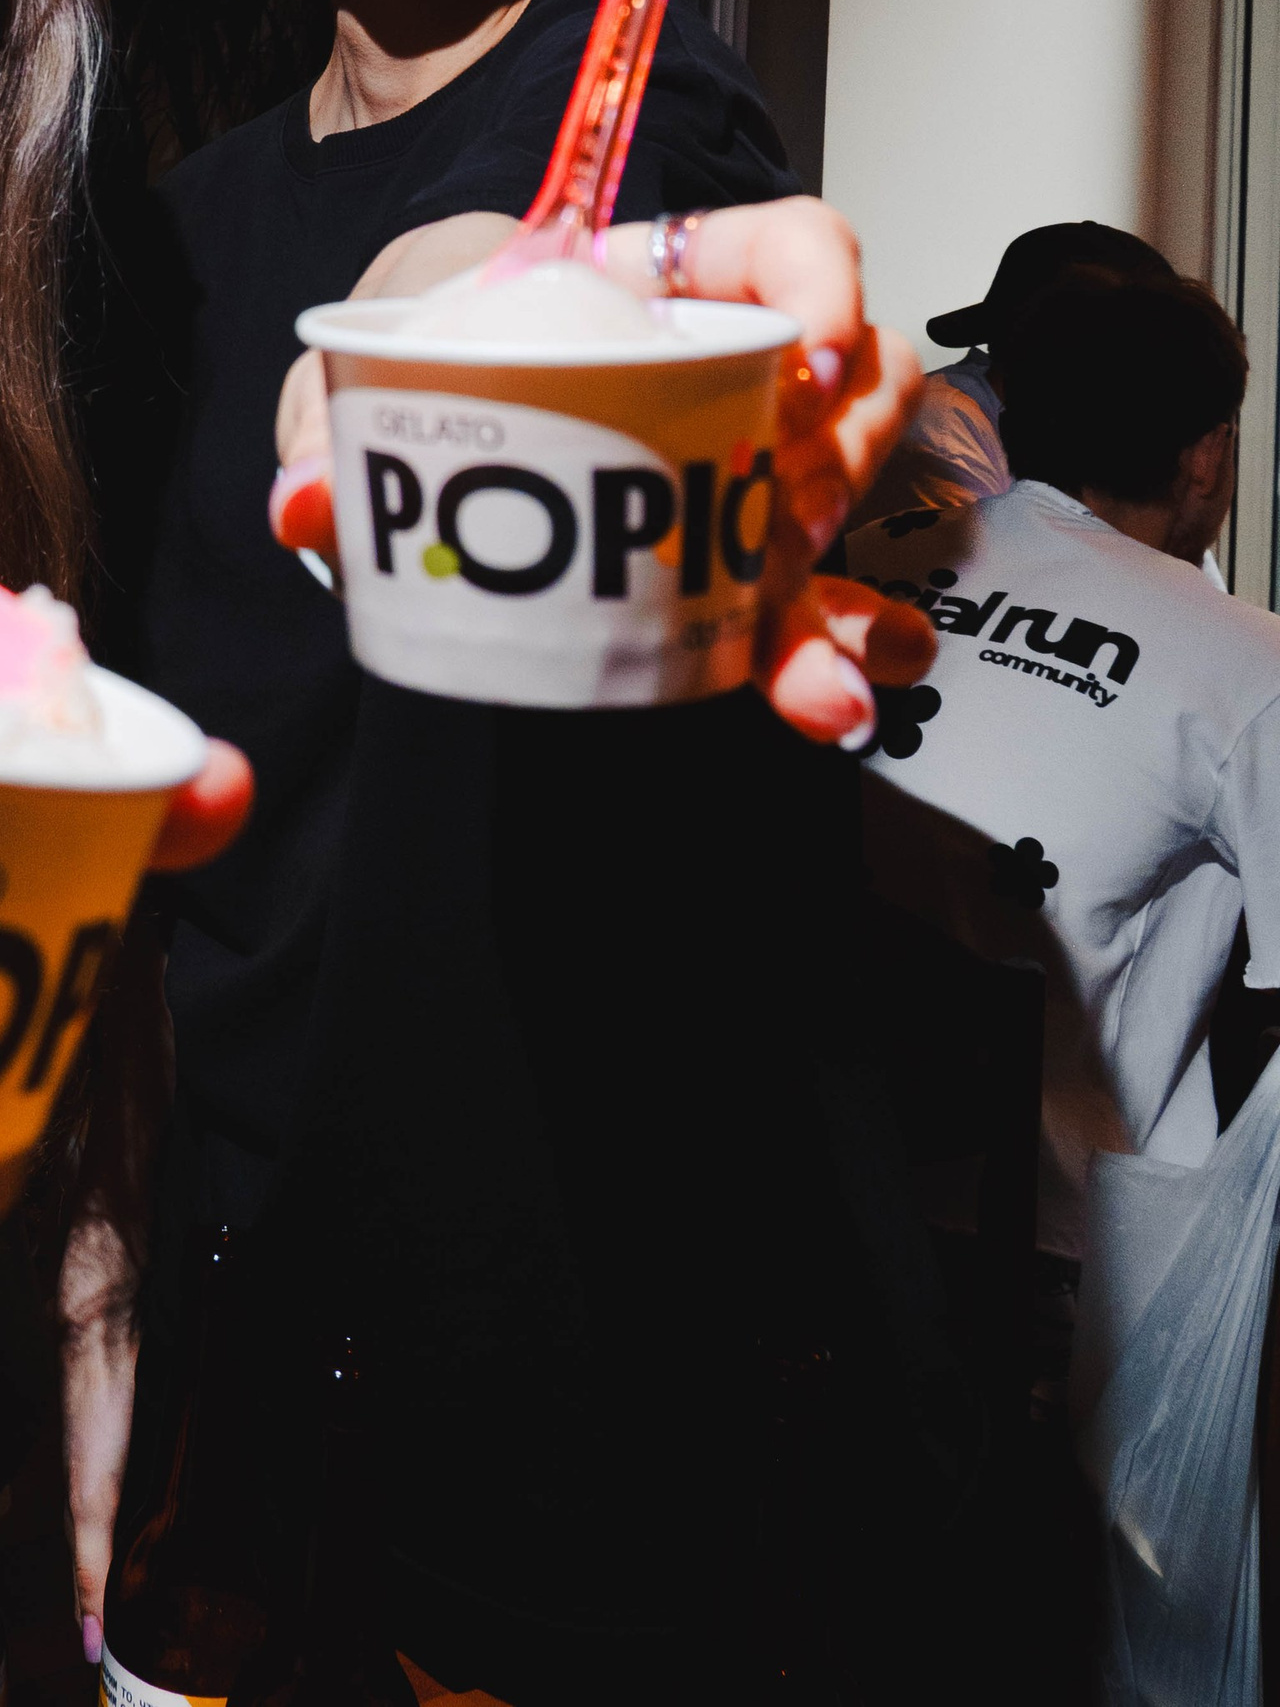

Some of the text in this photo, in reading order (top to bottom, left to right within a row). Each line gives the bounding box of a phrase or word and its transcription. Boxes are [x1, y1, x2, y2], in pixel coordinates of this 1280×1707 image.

[372, 404, 505, 452] GELATO
[856, 568, 1140, 686] ial run
[979, 649, 1118, 708] community
